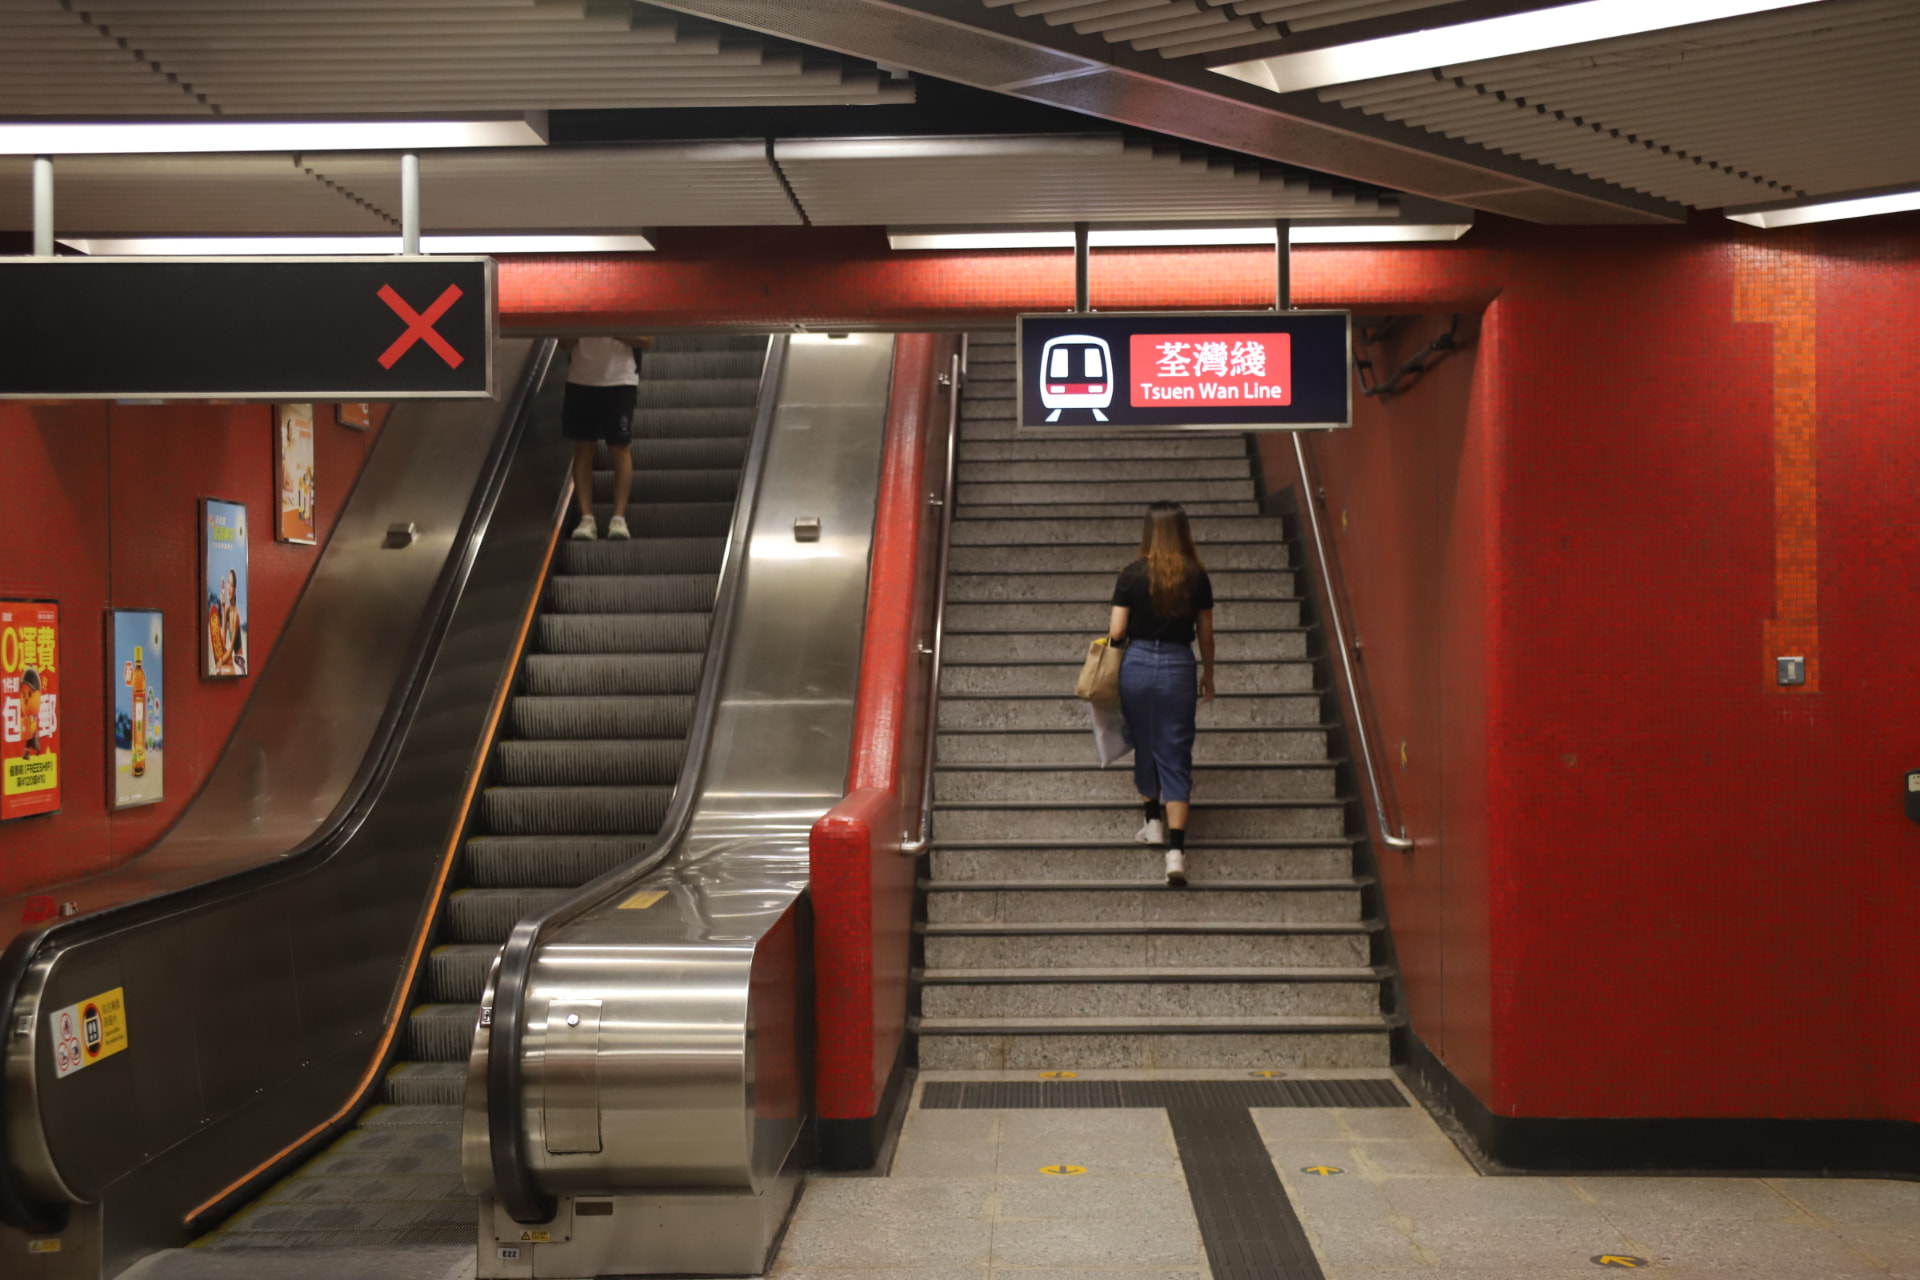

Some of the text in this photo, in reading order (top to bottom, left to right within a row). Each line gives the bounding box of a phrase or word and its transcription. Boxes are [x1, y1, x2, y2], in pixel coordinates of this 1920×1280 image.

[1140, 381, 1282, 400] Tsuen Wan Line
[502, 1250, 517, 1258] E22
